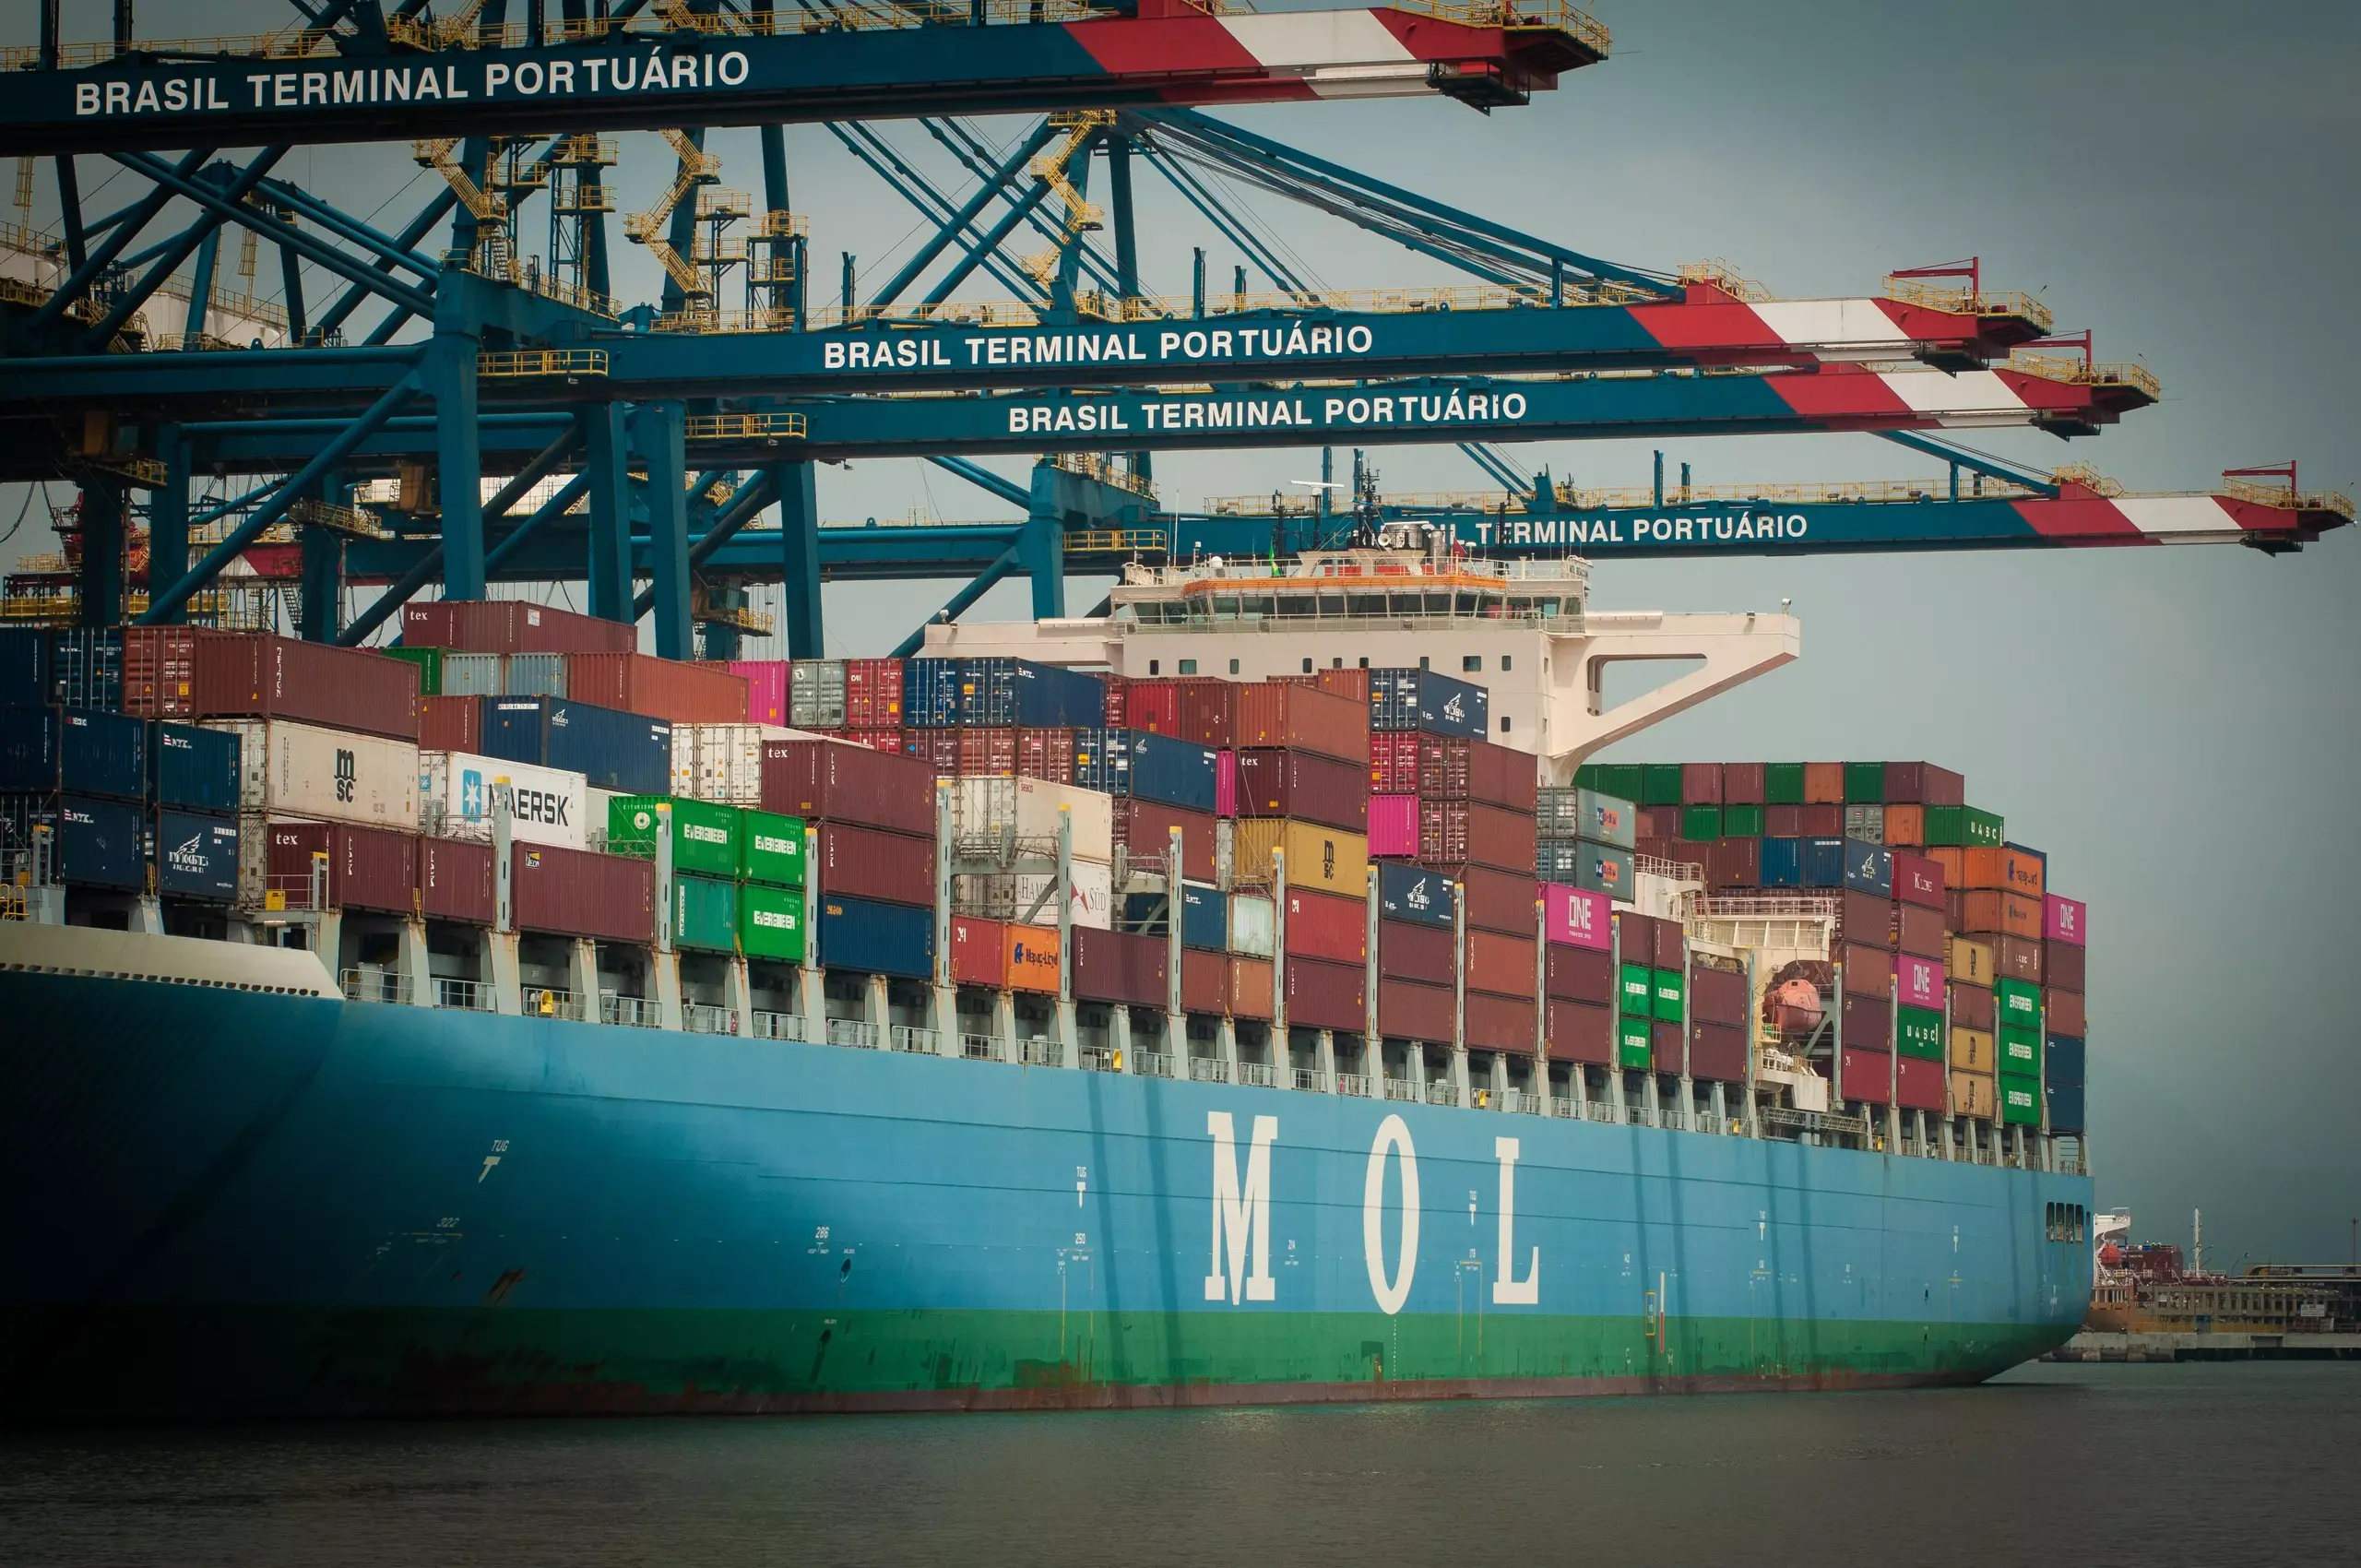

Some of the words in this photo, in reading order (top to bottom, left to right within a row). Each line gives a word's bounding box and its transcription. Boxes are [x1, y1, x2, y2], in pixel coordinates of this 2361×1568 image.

[76, 77, 229, 116] BRASIL
[246, 67, 469, 107] TERMINAL
[486, 46, 750, 96] PORTUÁRIO
[825, 341, 951, 369] BRASIL
[965, 335, 1146, 364] TERMINAL
[1160, 321, 1372, 359] PORTUÁRIO
[1009, 406, 1128, 433] BRASIL
[1142, 400, 1311, 428] TERMINAL
[1325, 388, 1526, 424] PORTUÁRIO
[1475, 519, 1623, 544] TERMINAL
[1633, 512, 1808, 541] PORTUÁRIO
[409, 610, 428, 621] tex
[768, 747, 789, 758] tex
[1241, 756, 1259, 766] tex
[276, 832, 299, 845] tex
[1970, 821, 1997, 839] UASC
[1089, 886, 1107, 911] SÜD
[1569, 895, 1592, 931] ONE
[2059, 903, 2074, 931] ONE
[1913, 964, 1930, 993] ONE
[1907, 1024, 1935, 1042] UASC
[492, 1139, 509, 1152] TUG
[1076, 1166, 1086, 1178] TUG
[436, 1217, 460, 1229] 322
